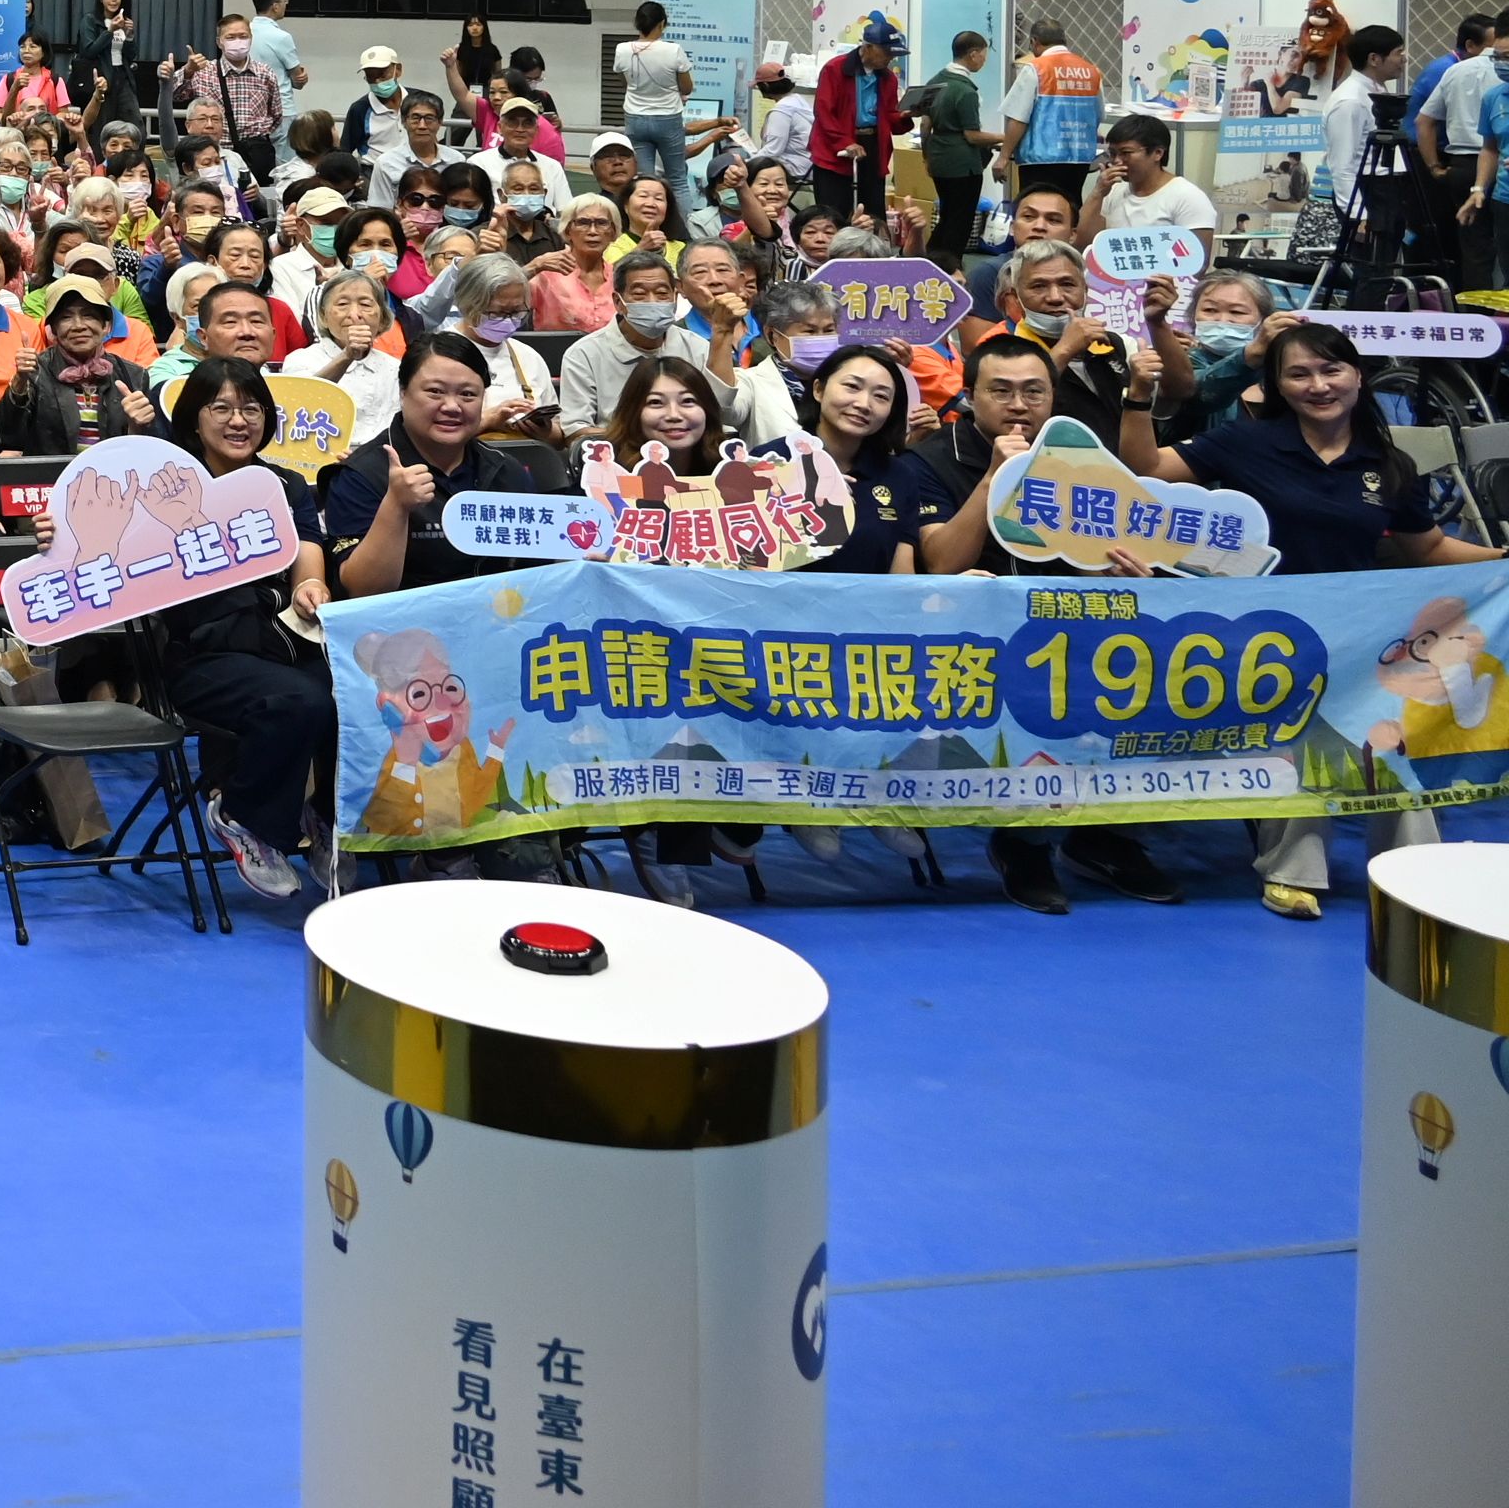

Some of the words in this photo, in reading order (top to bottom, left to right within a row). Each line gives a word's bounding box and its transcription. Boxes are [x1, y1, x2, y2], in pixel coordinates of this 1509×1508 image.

[1054, 66, 1091, 79] KAKU
[1108, 236, 1154, 253] 樂齡界
[1113, 255, 1159, 271] 扛霸子
[826, 278, 955, 324] 有所樂
[25, 504, 43, 513] VIP
[459, 502, 555, 525] 照顧神隊友
[613, 492, 827, 564] 照顧同行
[1013, 477, 1246, 553] 長照好厝邊
[21, 506, 283, 623] 牽手一起走
[1027, 590, 1139, 620] 請撥專線
[528, 628, 998, 723] 申請長照服務
[1023, 629, 1296, 722] 1966
[1110, 721, 1271, 757] 前五分鐘免費
[1340, 797, 1398, 812] 衛生福利部
[451, 1316, 498, 1508] 看見照顧
[535, 1336, 586, 1497] 在臺東
